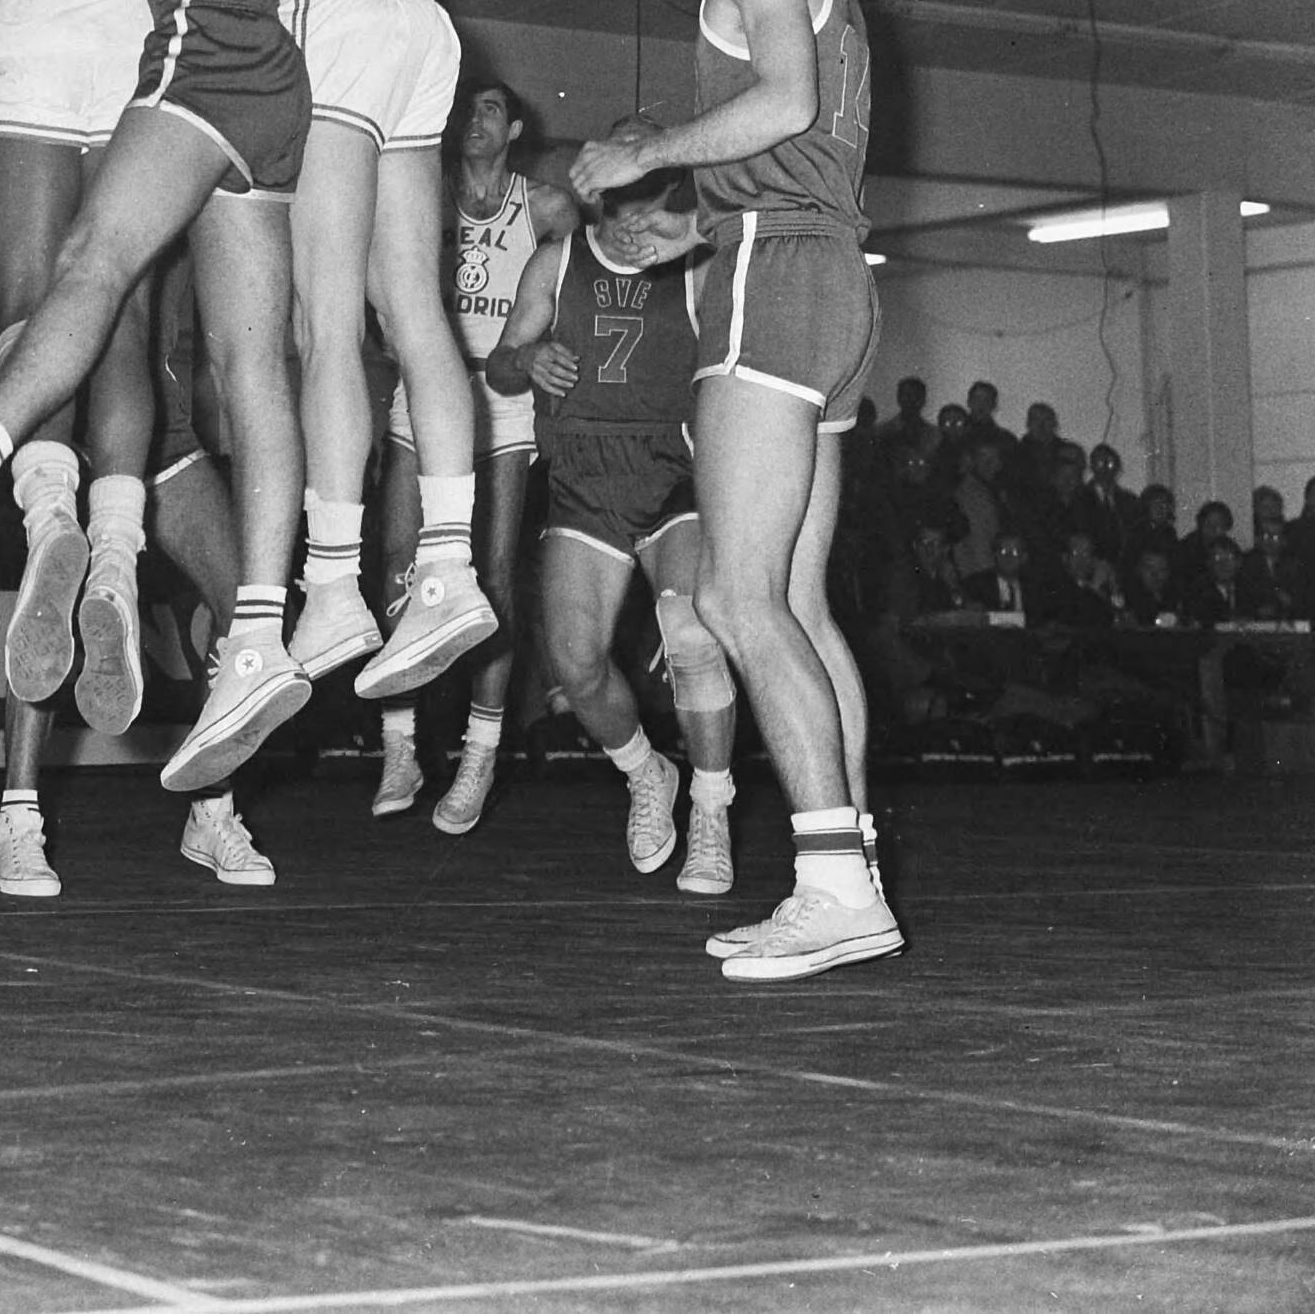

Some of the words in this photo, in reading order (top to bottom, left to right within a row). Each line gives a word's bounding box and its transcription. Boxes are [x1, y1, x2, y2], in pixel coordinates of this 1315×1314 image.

[507, 201, 523, 226] 7
[593, 278, 652, 310] SVE
[594, 315, 644, 383] 7
